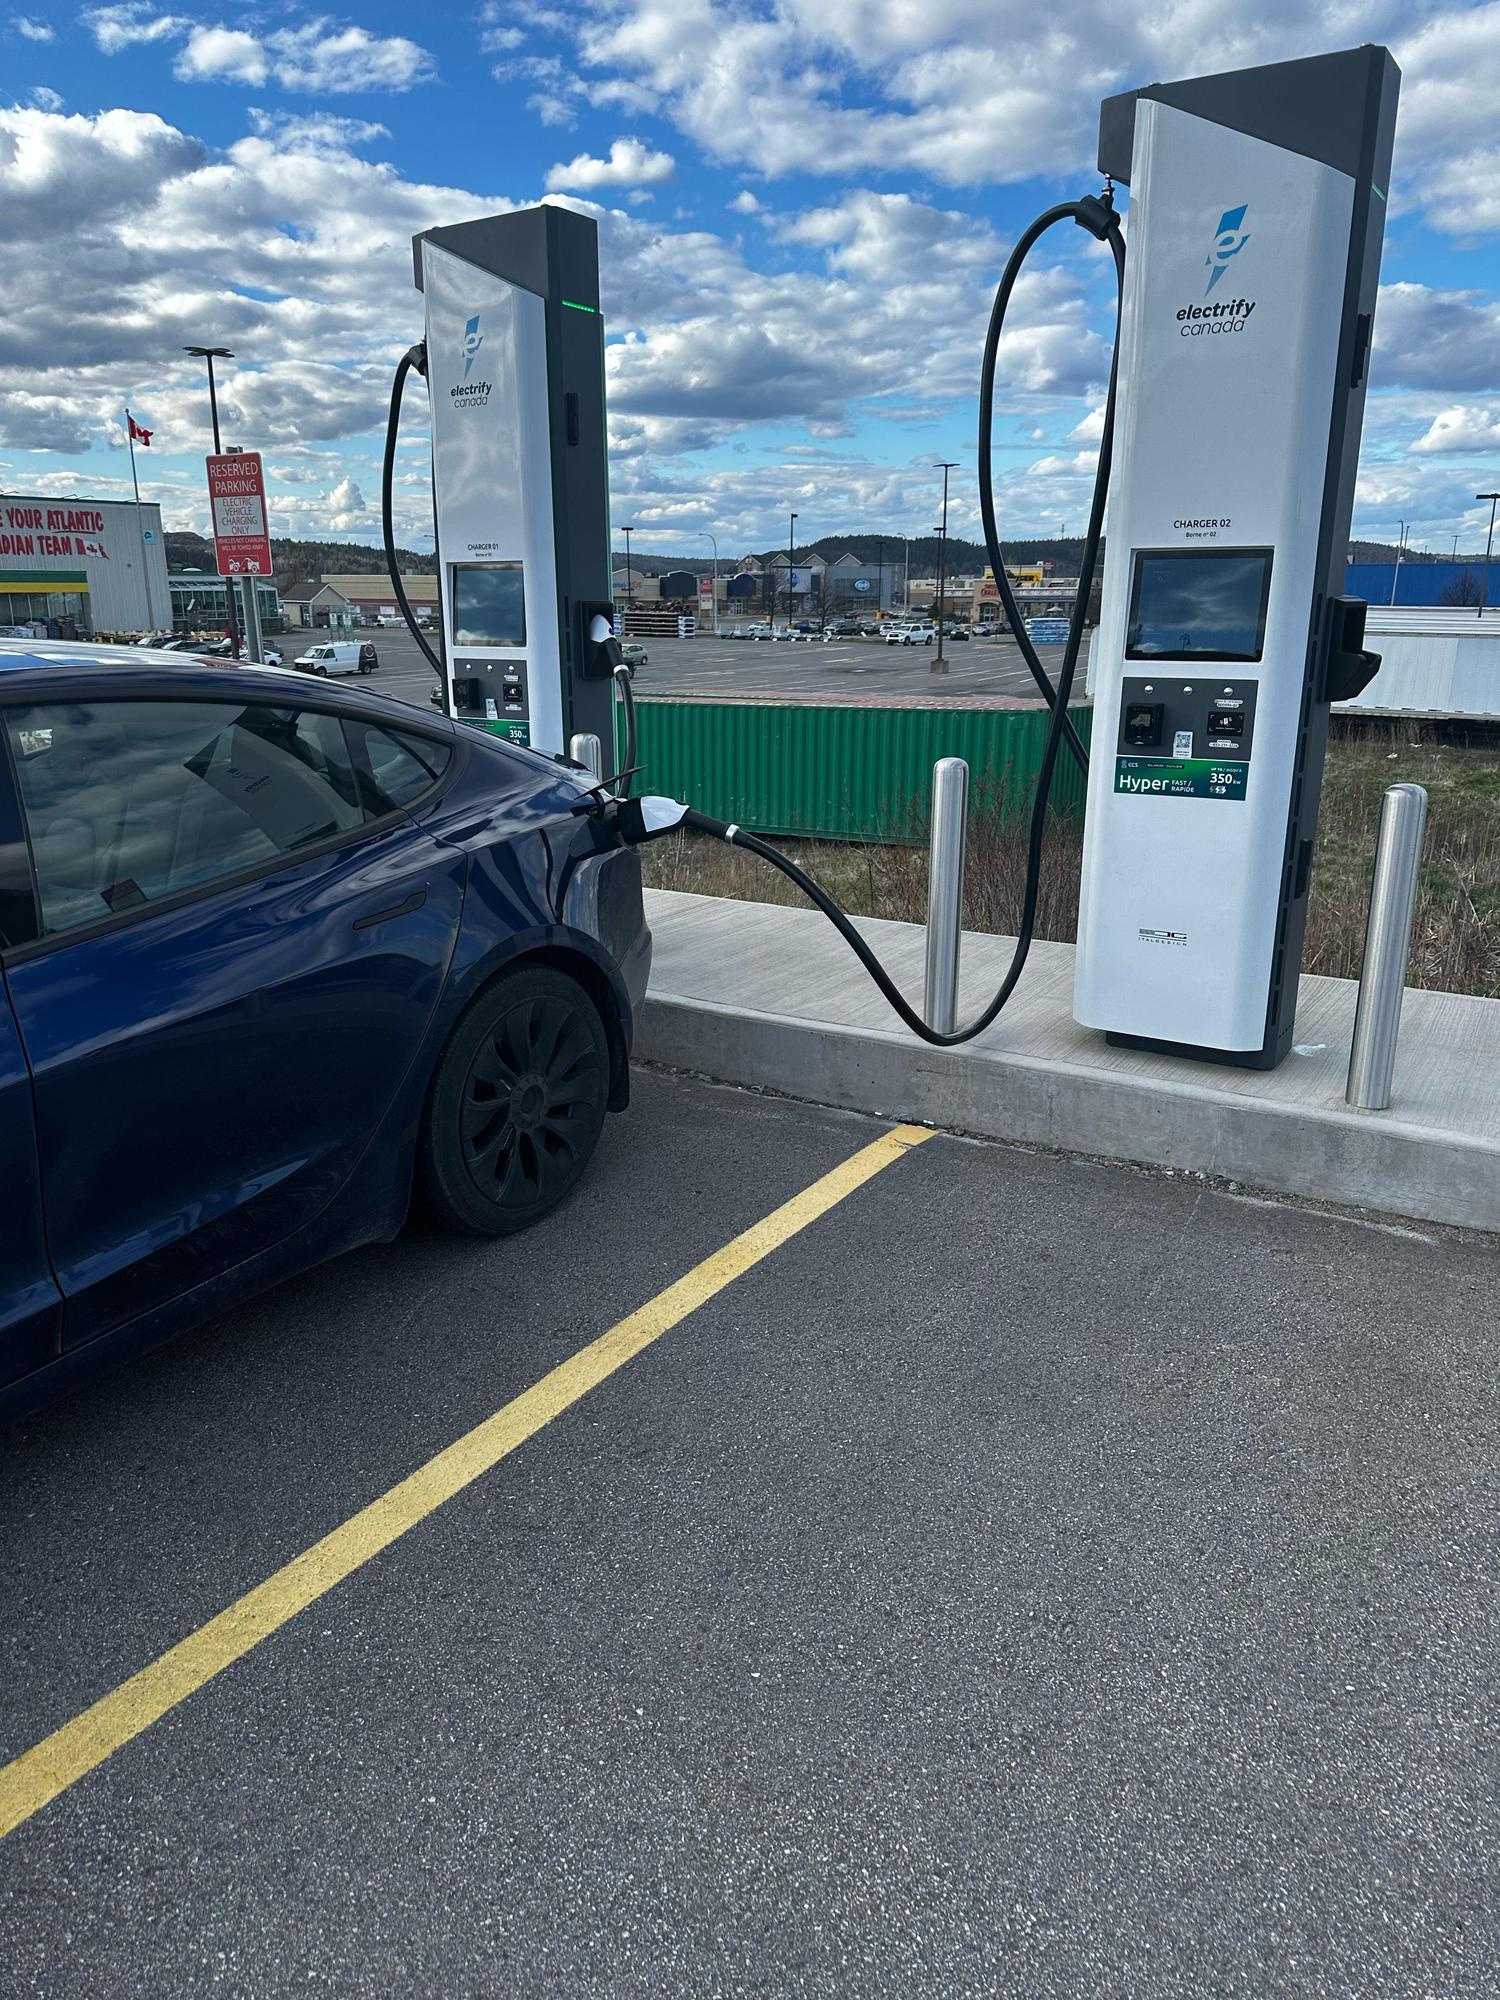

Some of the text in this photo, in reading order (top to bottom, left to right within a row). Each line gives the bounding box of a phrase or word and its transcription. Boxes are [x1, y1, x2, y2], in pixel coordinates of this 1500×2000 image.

[1176, 298, 1256, 321] electrify
[1180, 316, 1246, 337] canada
[450, 381, 492, 397] electrify
[454, 394, 488, 409] canada
[210, 462, 258, 477] RESERVED
[215, 479, 257, 494] PARKING
[223, 497, 253, 507] ELECTRIC
[225, 506, 253, 516] VEHICLE
[6, 507, 44, 529] YOUR
[47, 509, 104, 531] ATLANTIC
[222, 516, 258, 526] CHARGING
[1173, 518, 1231, 529] CHARGER 02
[231, 526, 250, 535] ONLY
[37, 535, 73, 556] TEAM
[467, 543, 492, 551] CHARGER
[509, 730, 523, 738] 350
[1119, 775, 1169, 793] Hyper
[1209, 773, 1233, 784] 350
